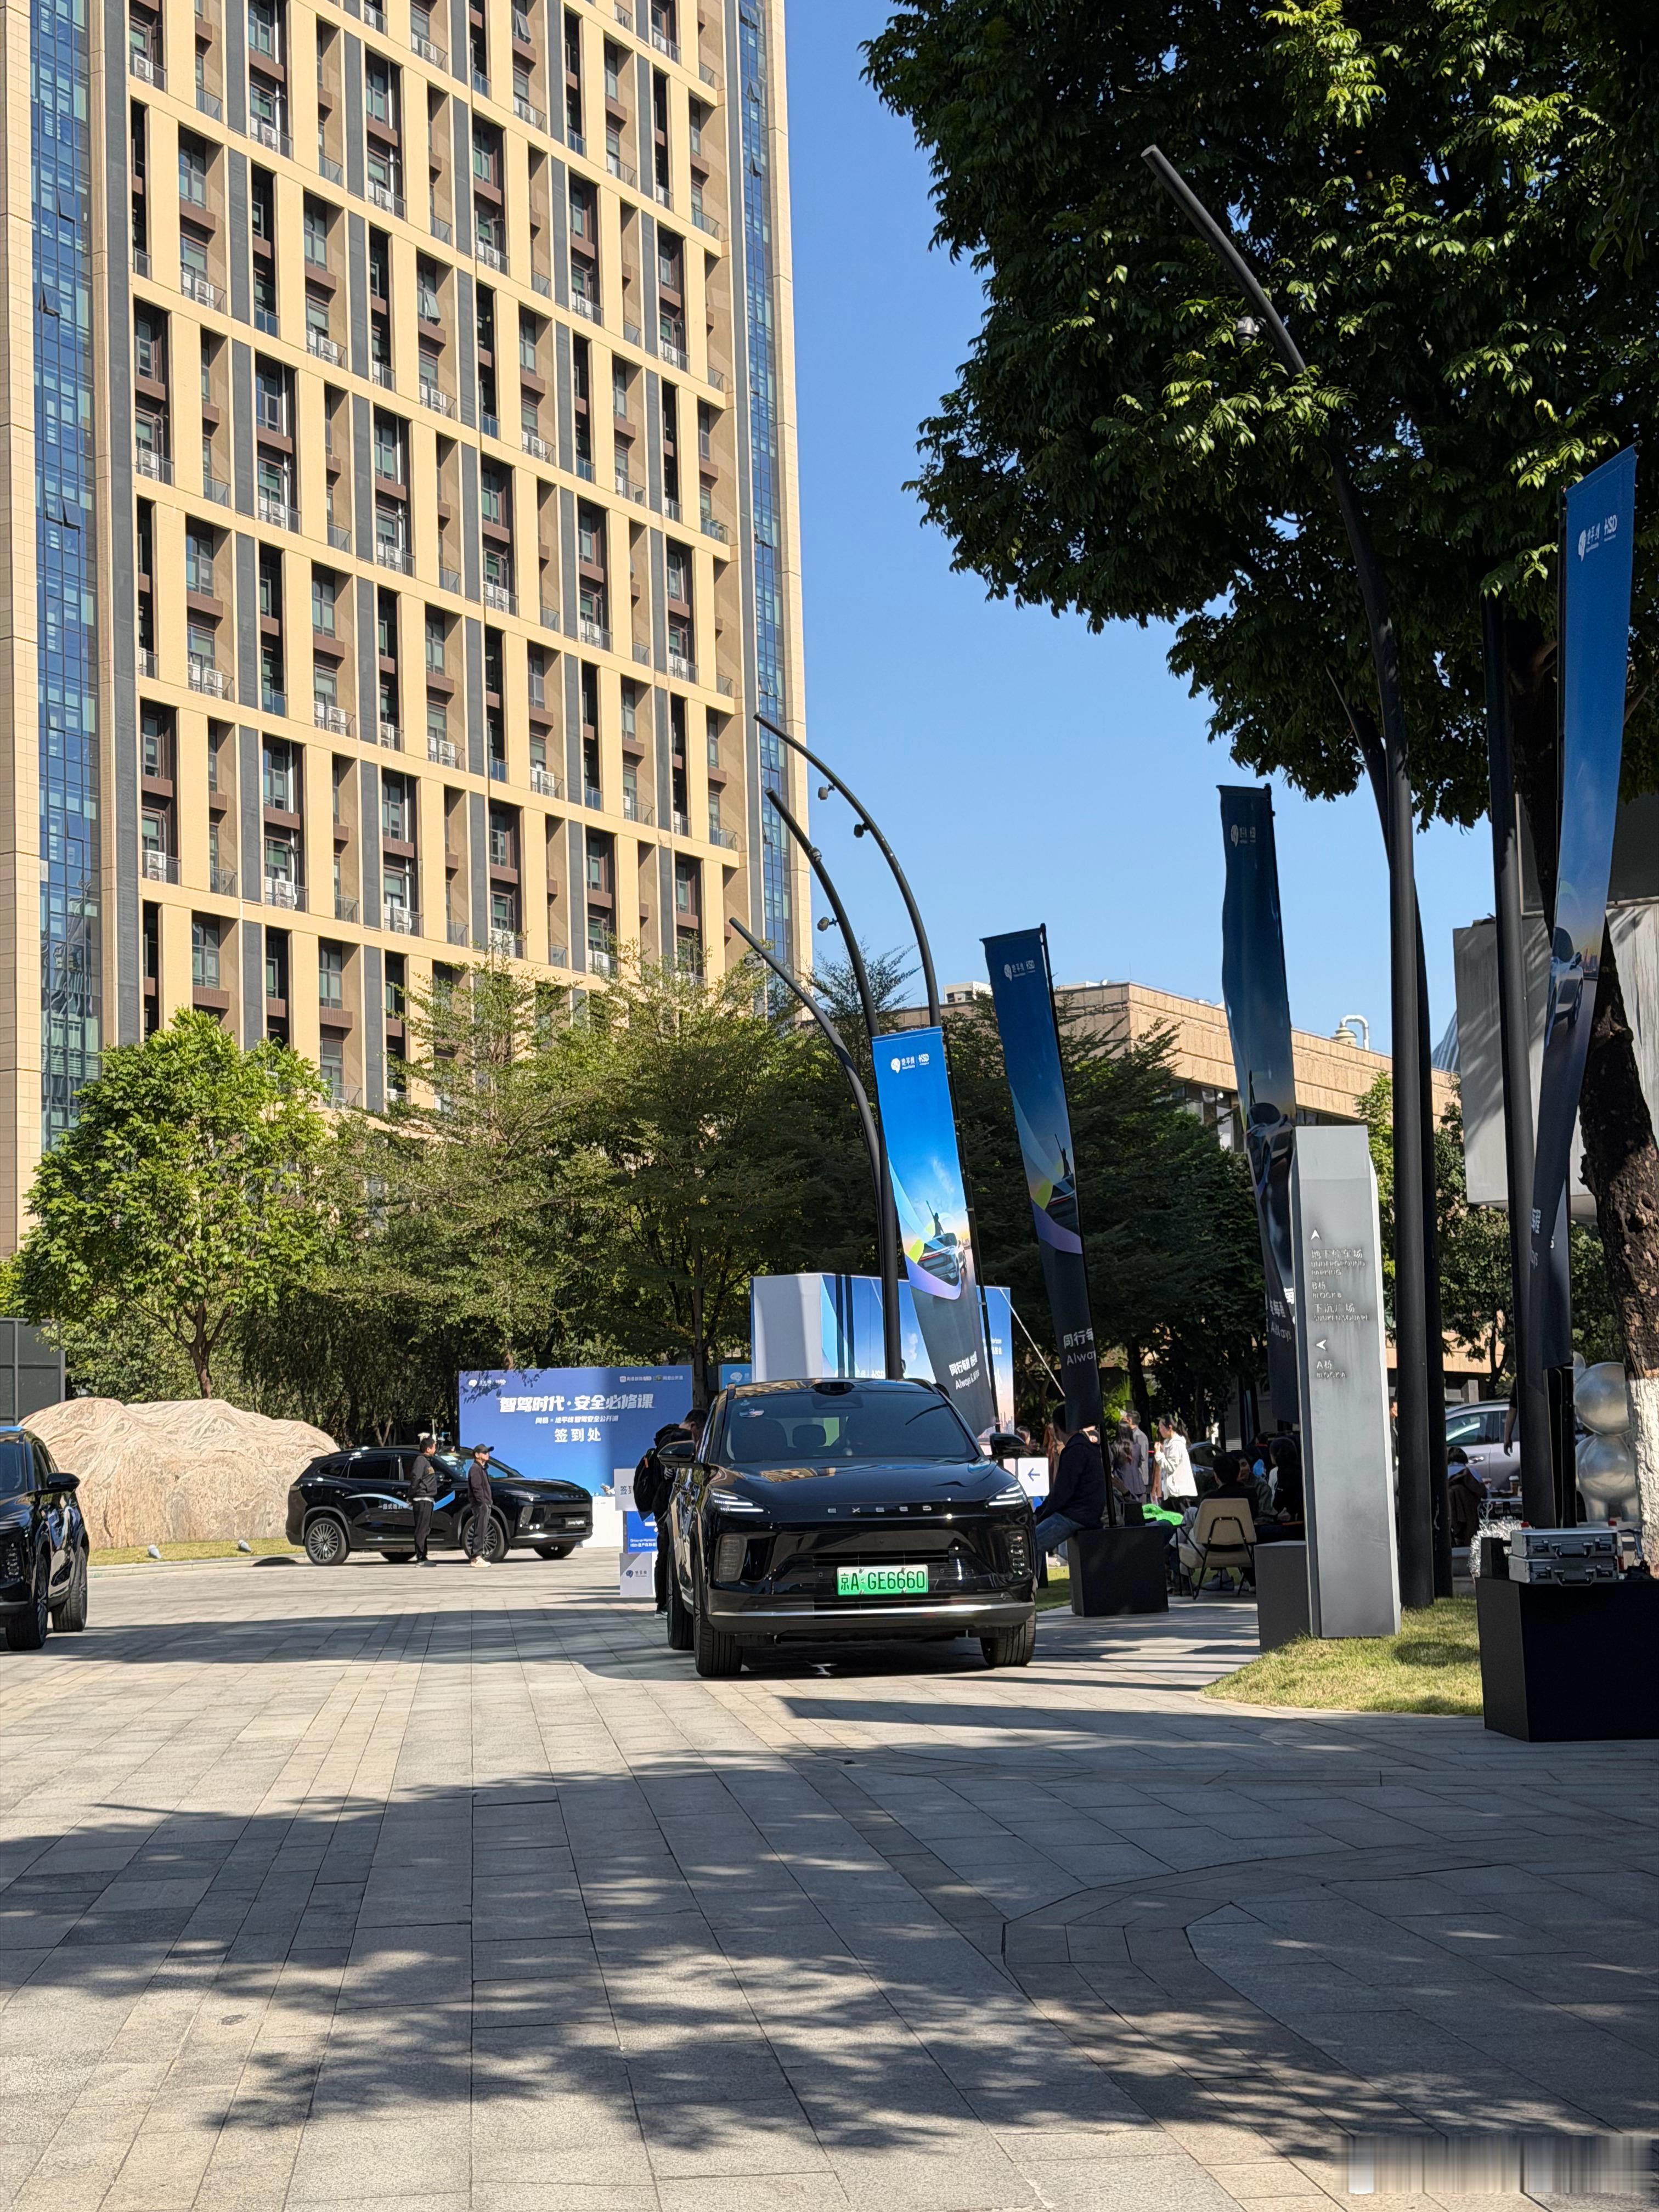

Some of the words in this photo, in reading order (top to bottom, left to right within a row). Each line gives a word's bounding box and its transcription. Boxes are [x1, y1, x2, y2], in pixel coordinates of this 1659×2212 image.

[1311, 1249, 1363, 1259] 地下停车场
[1314, 1303, 1355, 1313] 下沉广场
[554, 1427, 601, 1443] 签到处
[827, 1505, 932, 1514] EXEED
[840, 1572, 860, 1590] 京A
[867, 1571, 925, 1590] GE6660
